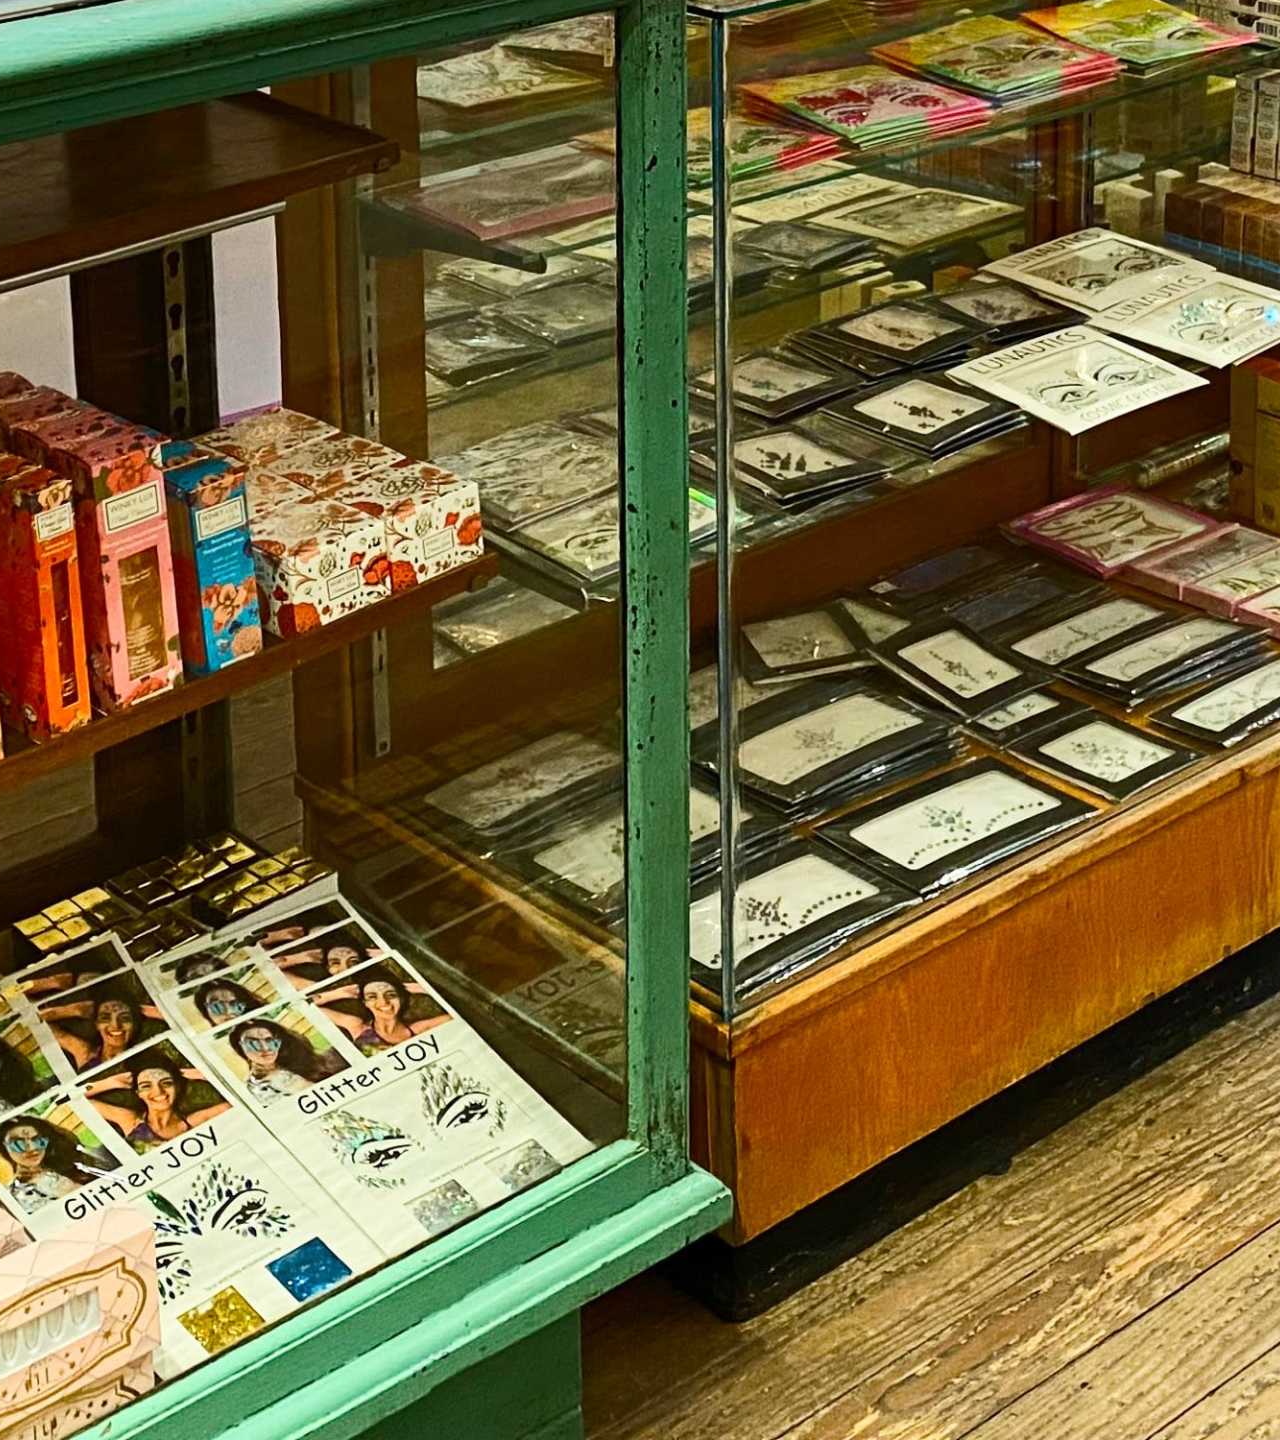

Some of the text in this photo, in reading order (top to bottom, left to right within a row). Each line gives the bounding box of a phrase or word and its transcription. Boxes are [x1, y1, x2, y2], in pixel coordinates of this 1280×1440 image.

[1103, 272, 1206, 321] LUNAUTICS
[967, 330, 1087, 375] LUNAUTICS
[296, 1032, 442, 1116] Glitter JOY
[63, 1124, 219, 1221] Glitter JOY
